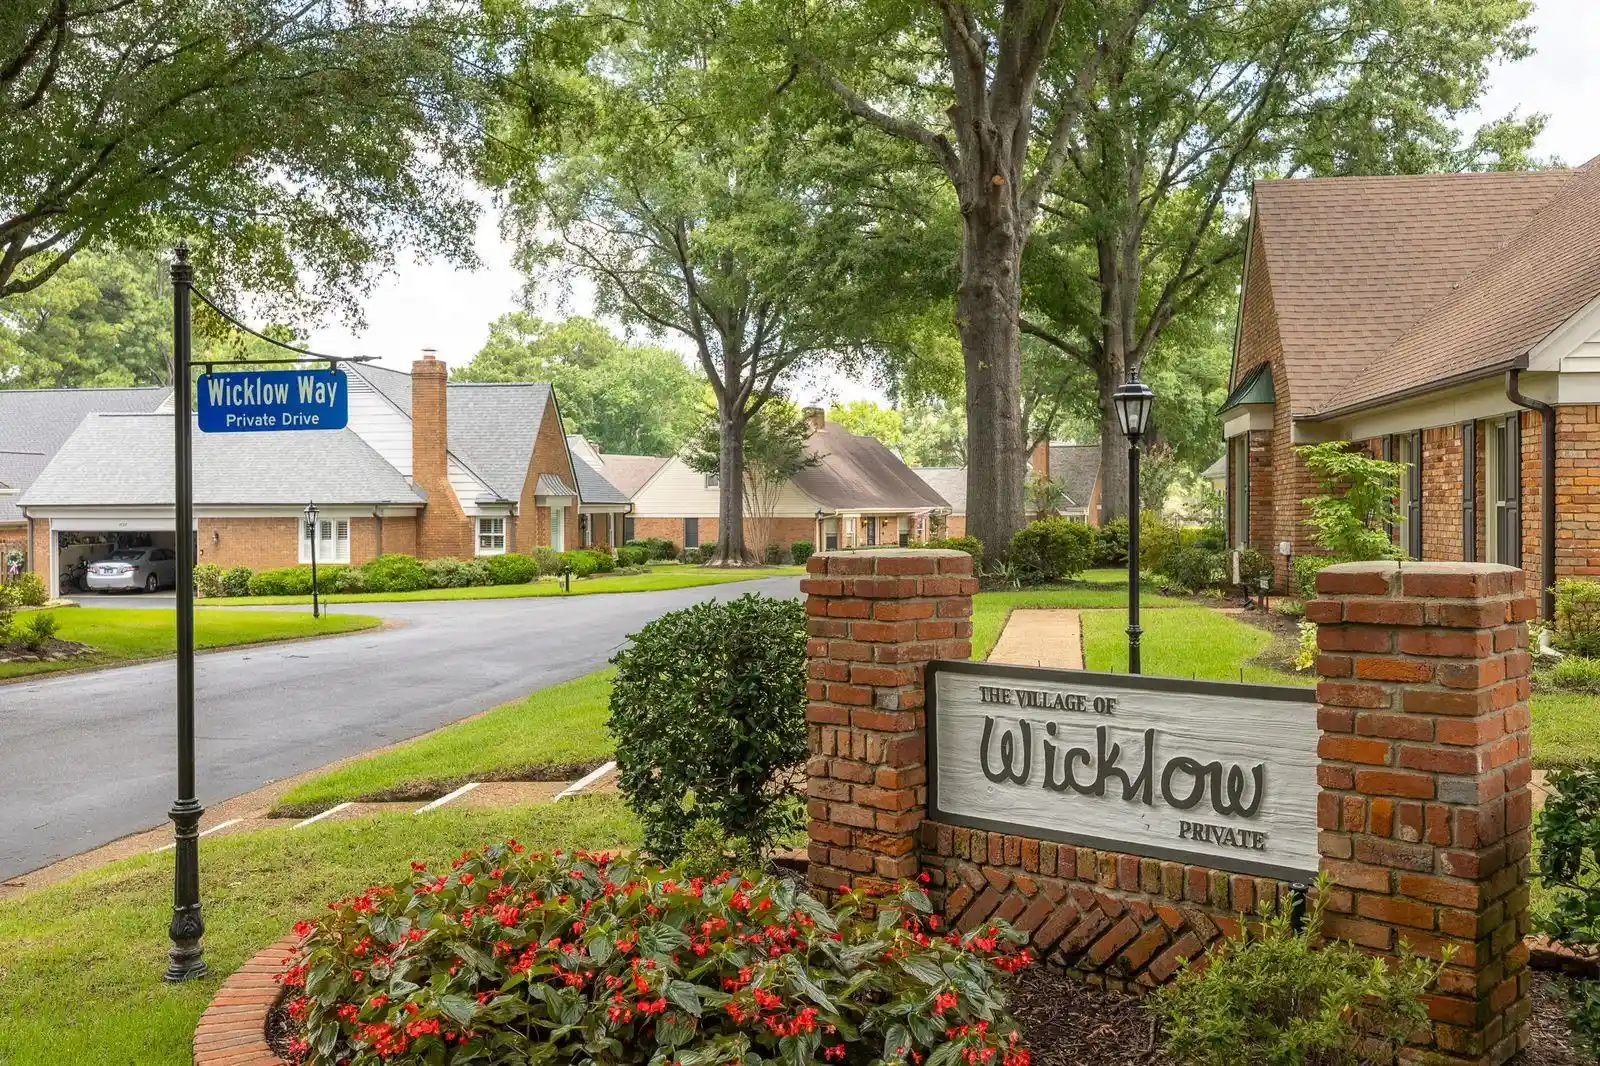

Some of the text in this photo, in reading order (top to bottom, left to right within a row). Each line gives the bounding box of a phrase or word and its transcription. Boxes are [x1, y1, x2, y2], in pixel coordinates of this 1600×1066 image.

[208, 375, 338, 408] Wicklow Way
[226, 411, 320, 427] Private Drive
[979, 685, 1117, 715] THE VILLAGE OF
[980, 714, 1264, 818] Wicklow
[1179, 819, 1267, 850] PRIVATE
